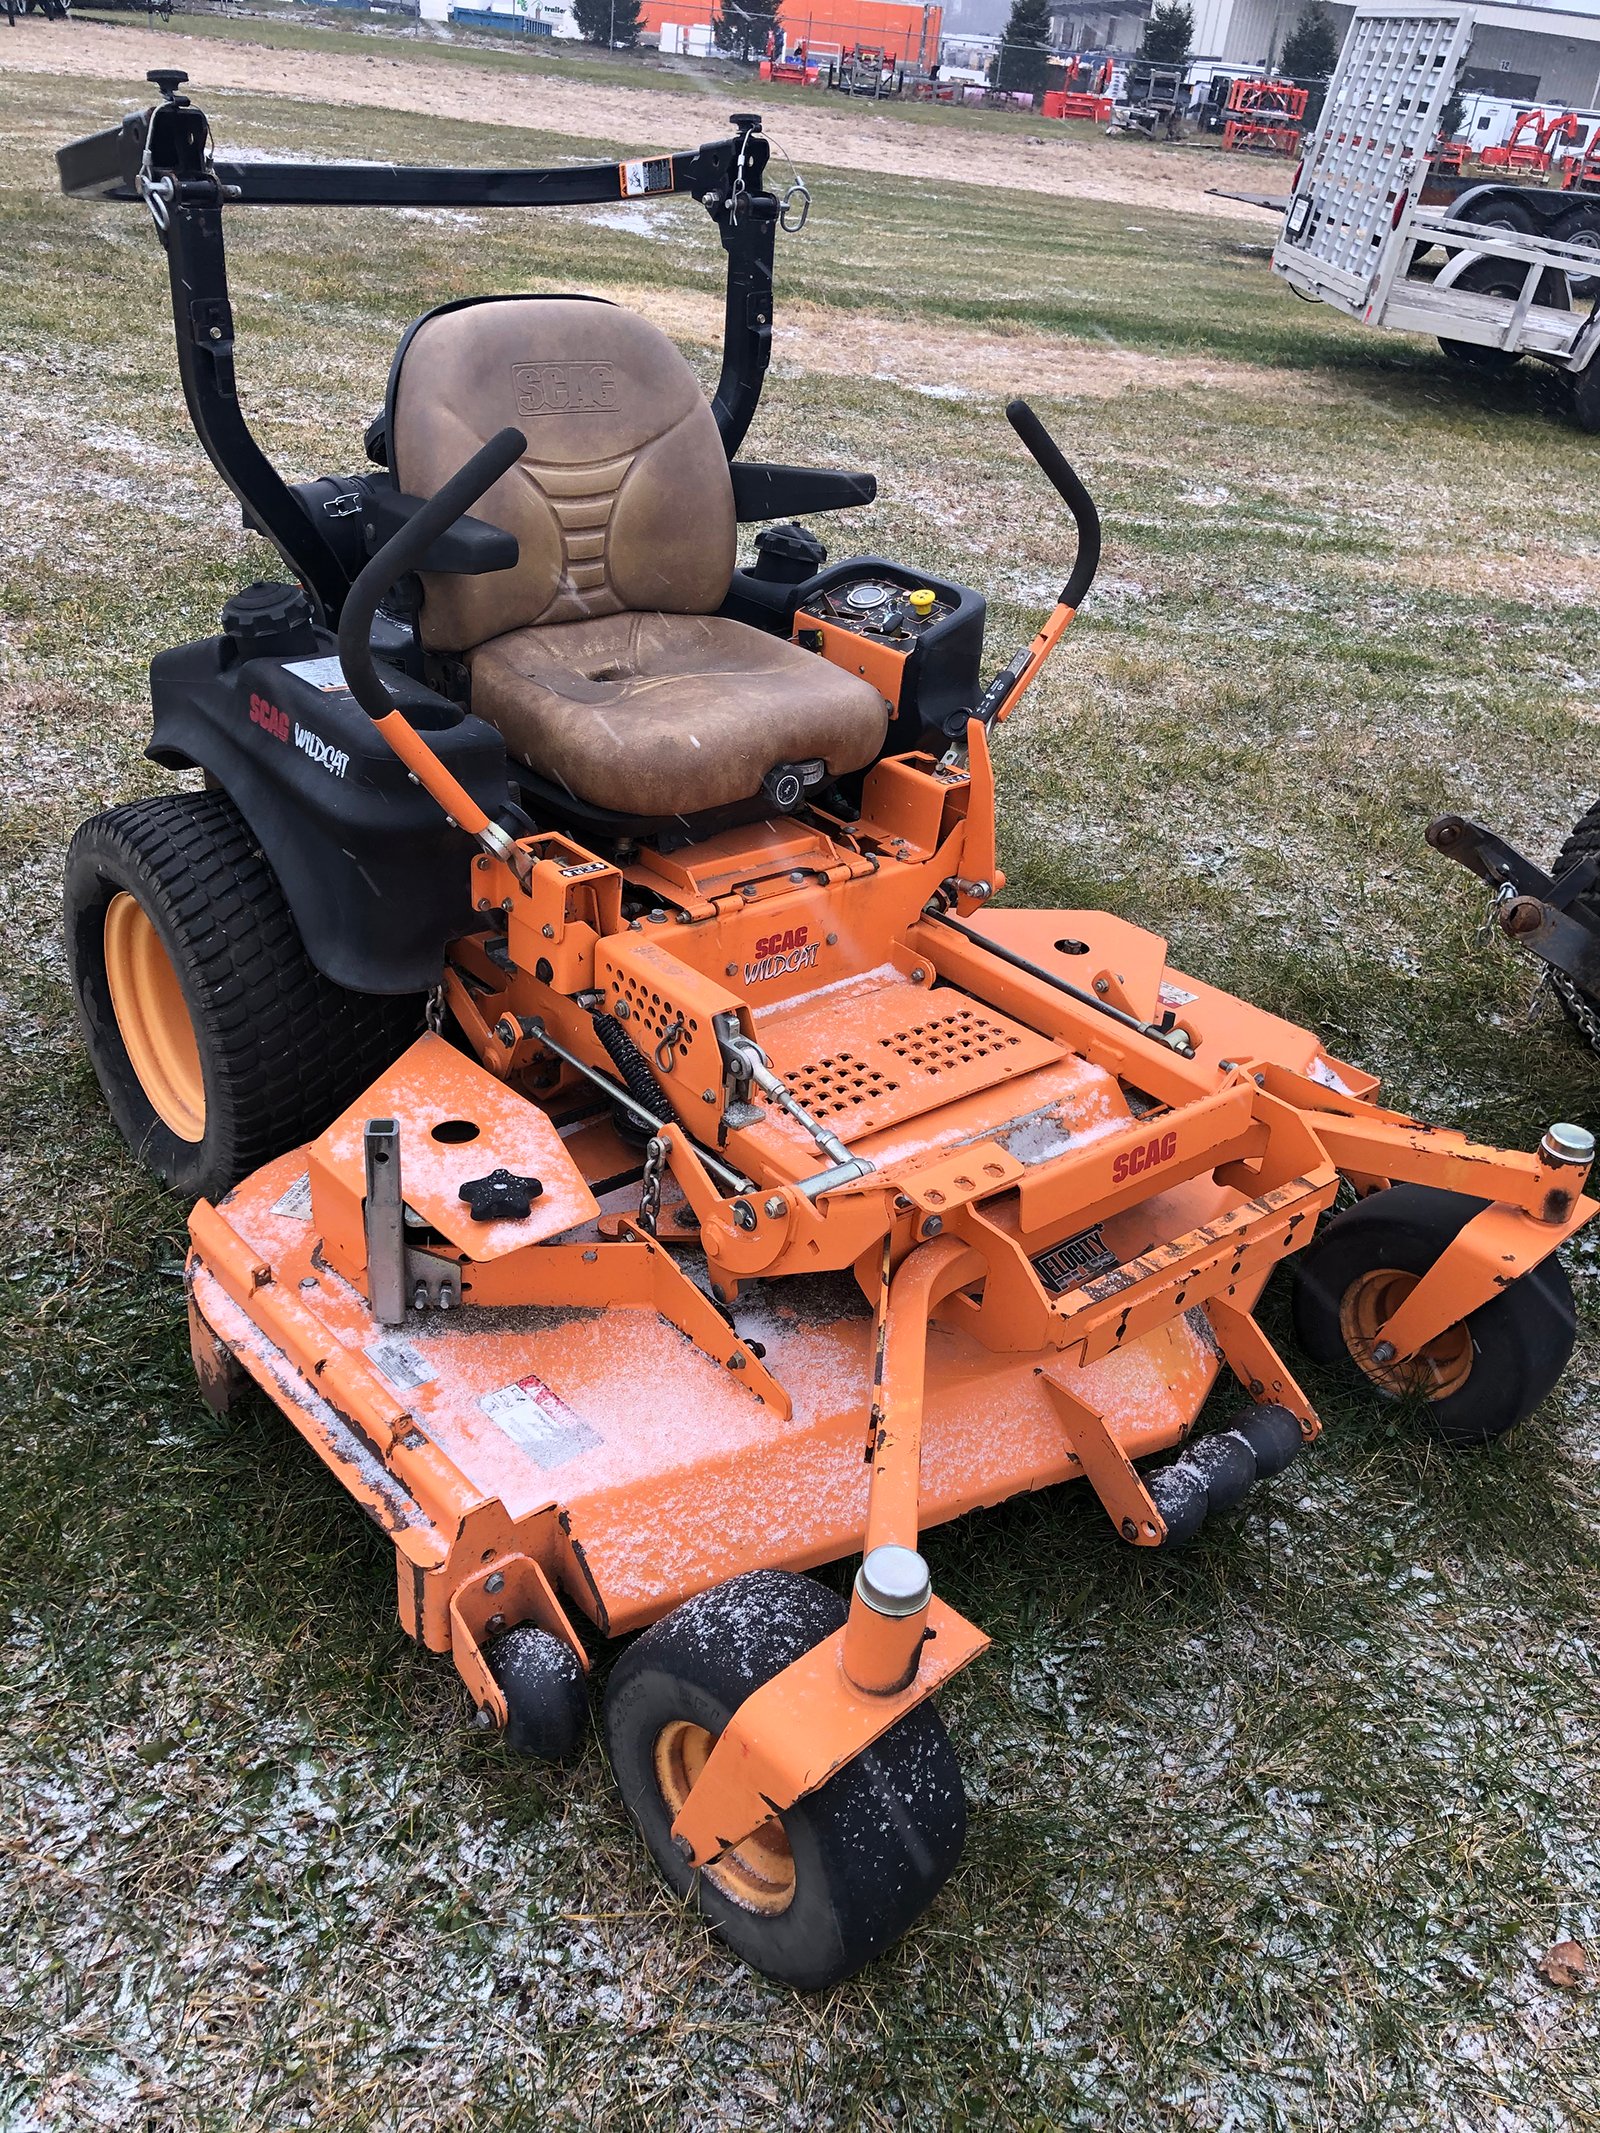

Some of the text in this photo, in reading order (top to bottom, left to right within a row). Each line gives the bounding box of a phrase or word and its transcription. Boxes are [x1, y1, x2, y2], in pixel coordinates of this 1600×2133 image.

[516, 366, 617, 410] SCAG
[249, 693, 350, 778] SCAG WILDCAT
[744, 941, 820, 986] WILDCAT
[755, 926, 808, 959] SCAG
[1112, 1131, 1177, 1183] SCAG
[1030, 1221, 1109, 1294] VELOCITY
